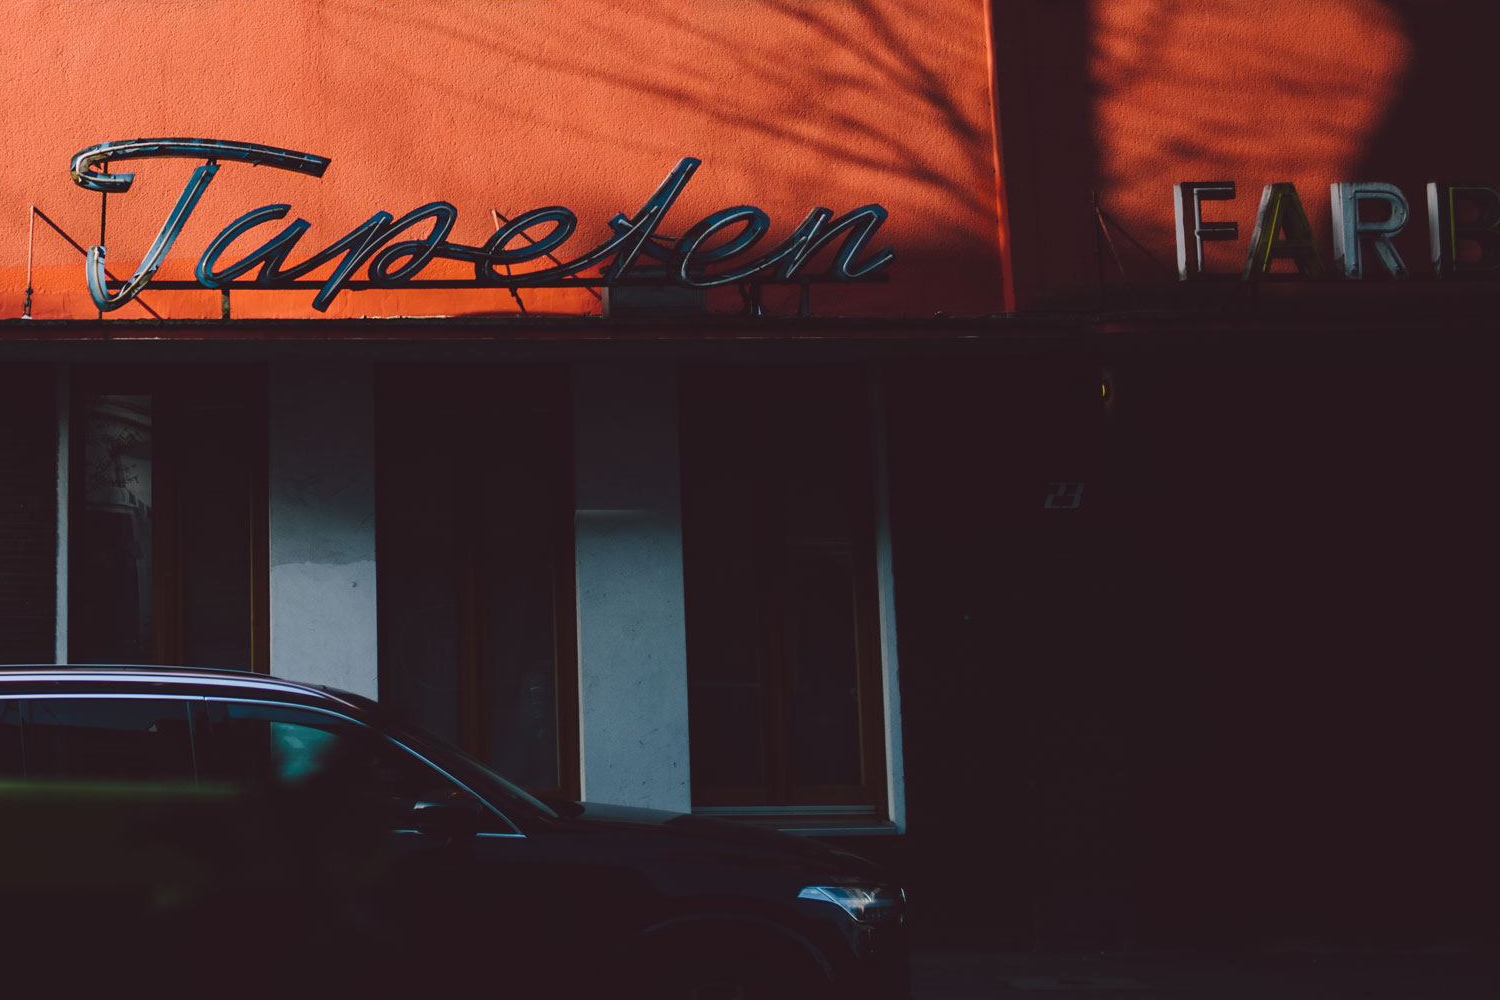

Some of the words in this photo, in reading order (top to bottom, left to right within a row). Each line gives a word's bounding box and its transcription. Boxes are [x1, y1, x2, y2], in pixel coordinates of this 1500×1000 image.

[70, 137, 897, 312] Tapeten
[1173, 181, 1500, 282] FARB
[1044, 481, 1085, 509] 23
